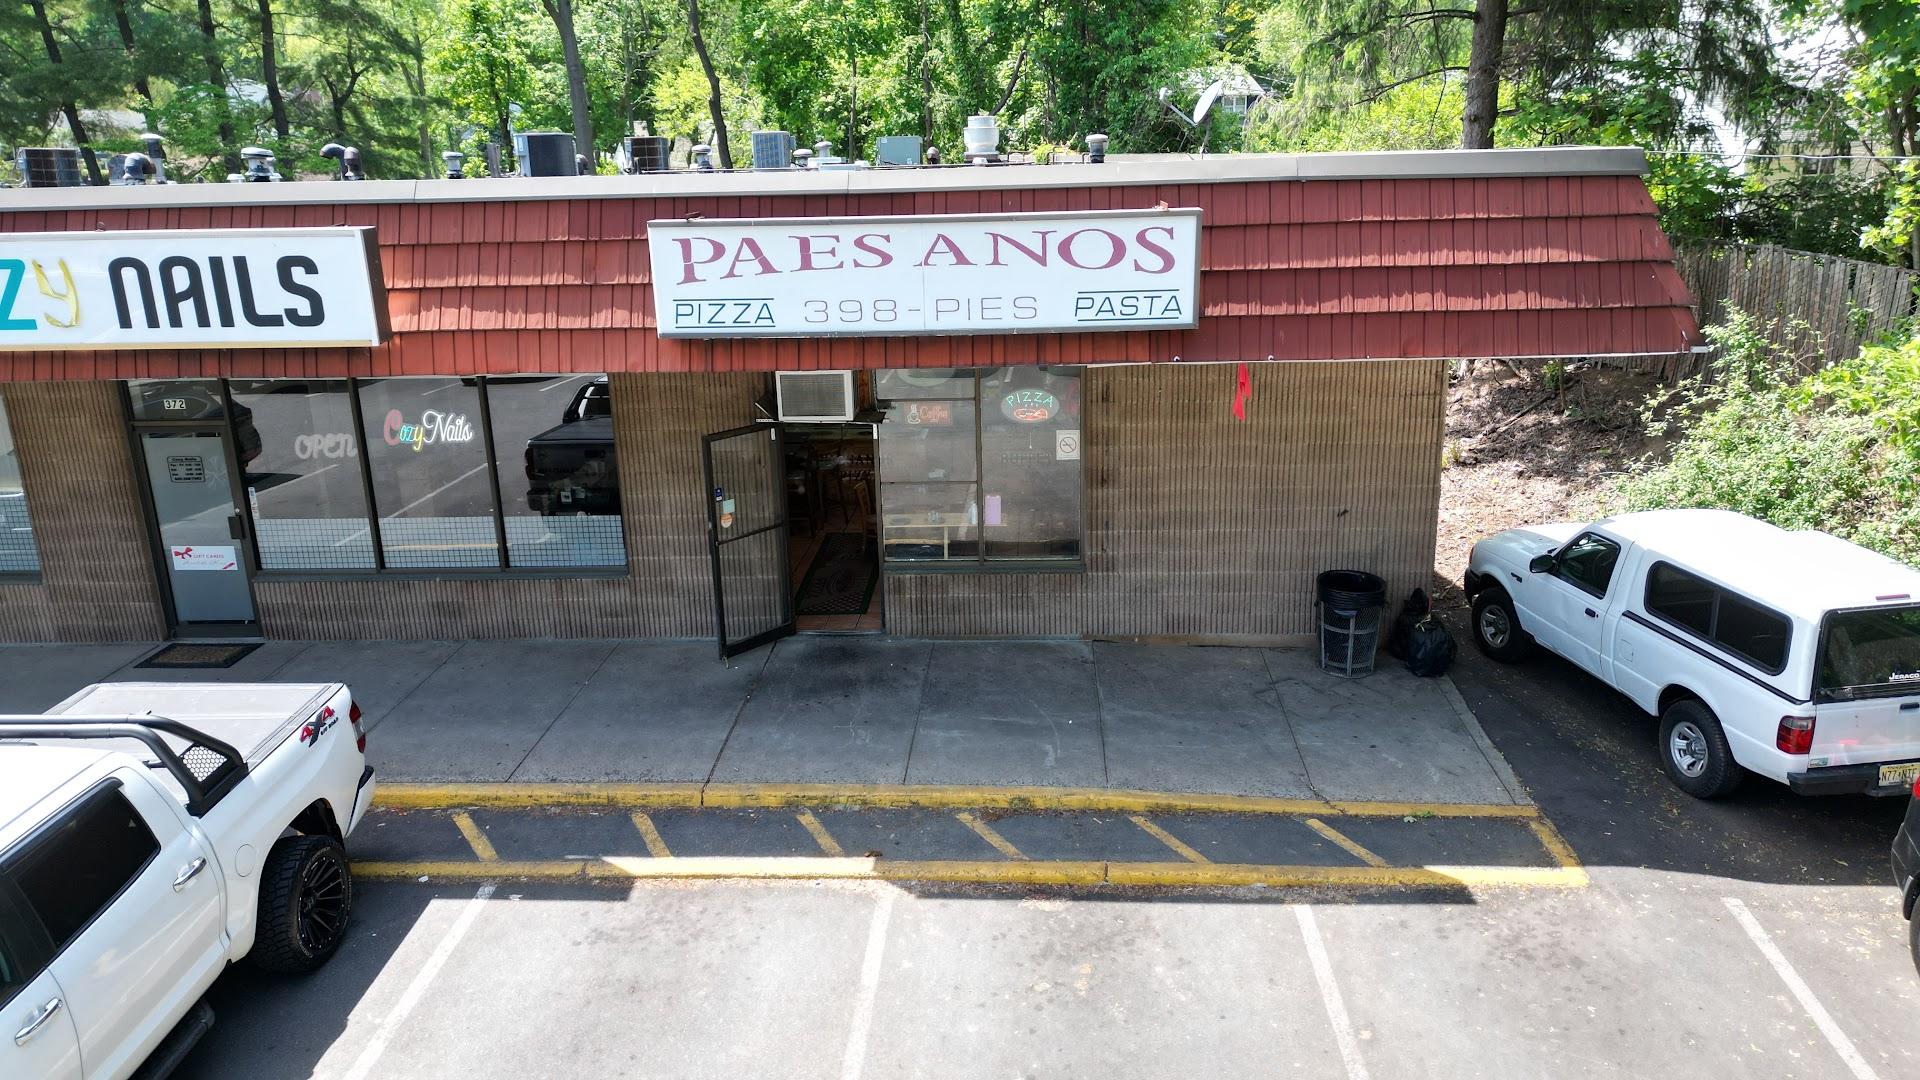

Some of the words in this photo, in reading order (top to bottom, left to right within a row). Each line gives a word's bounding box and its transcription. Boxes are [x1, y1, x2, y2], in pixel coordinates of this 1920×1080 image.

[108, 255, 325, 329] NAILS
[675, 302, 775, 324] PIZZA
[804, 295, 1038, 323] 398-PIES
[1074, 295, 1182, 317] PASTA
[165, 399, 185, 409] 372
[1006, 391, 1054, 408] PIZZA
[422, 409, 473, 443] Nails
